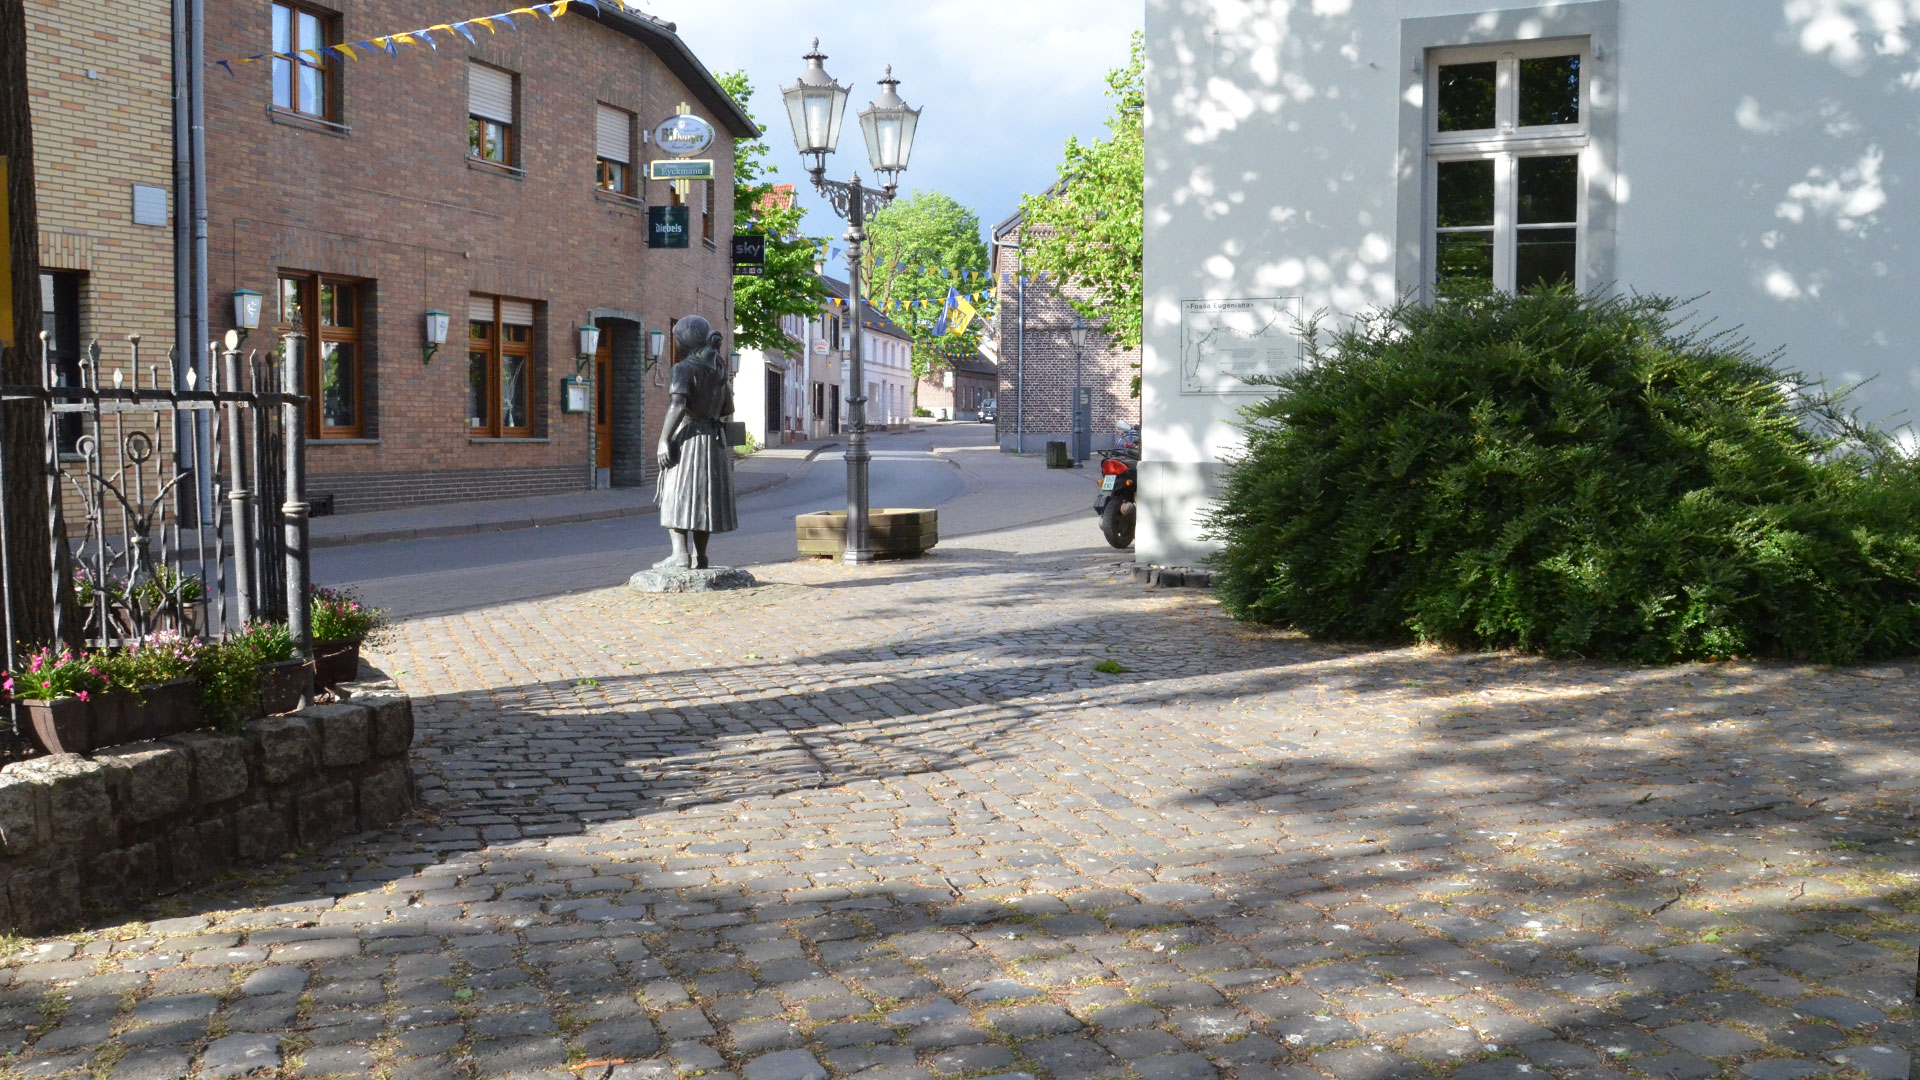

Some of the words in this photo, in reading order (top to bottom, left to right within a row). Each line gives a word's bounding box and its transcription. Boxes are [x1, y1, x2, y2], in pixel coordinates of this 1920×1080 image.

[661, 167, 703, 177] Eyckmann
[655, 222, 682, 233] Diebels
[735, 241, 760, 257] sky
